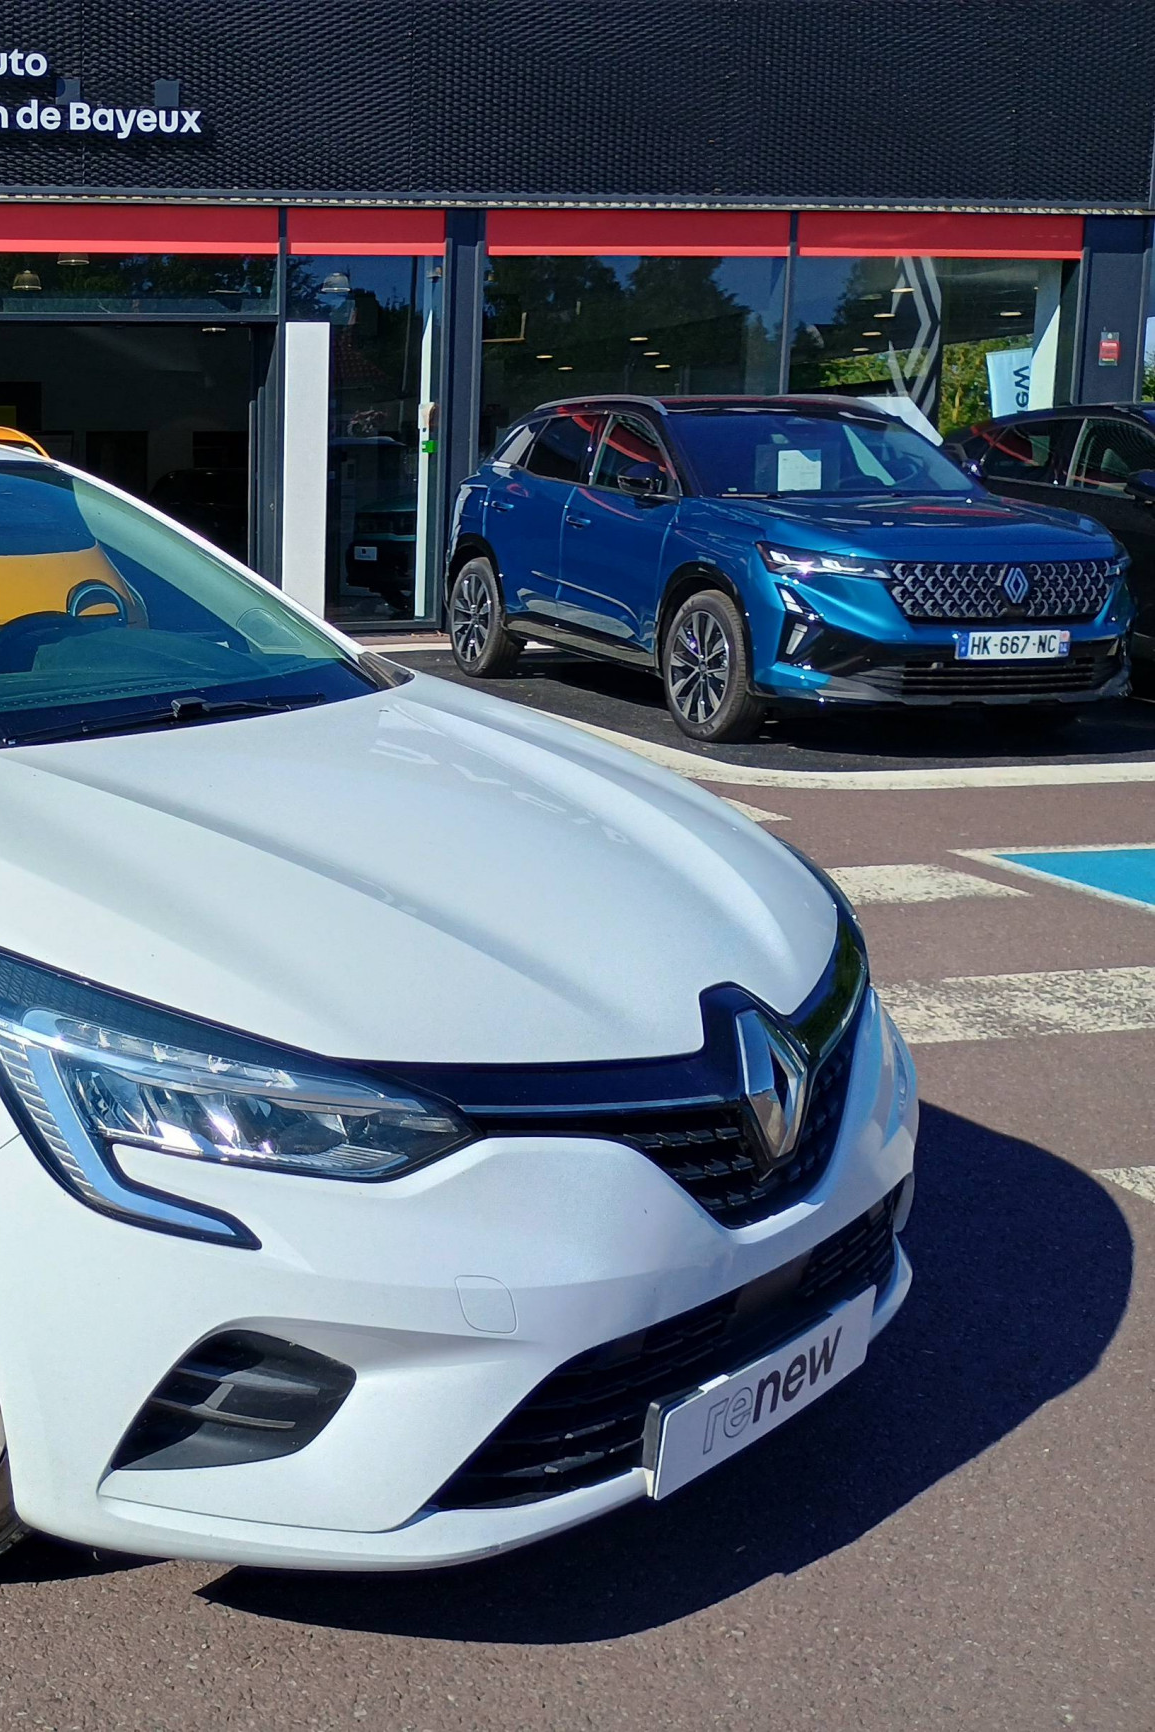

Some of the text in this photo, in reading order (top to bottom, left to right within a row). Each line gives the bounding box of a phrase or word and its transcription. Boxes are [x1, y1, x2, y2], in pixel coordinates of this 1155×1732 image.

[16, 99, 61, 130] de
[69, 102, 202, 139] Bayeux
[702, 1325, 843, 1456] renew
